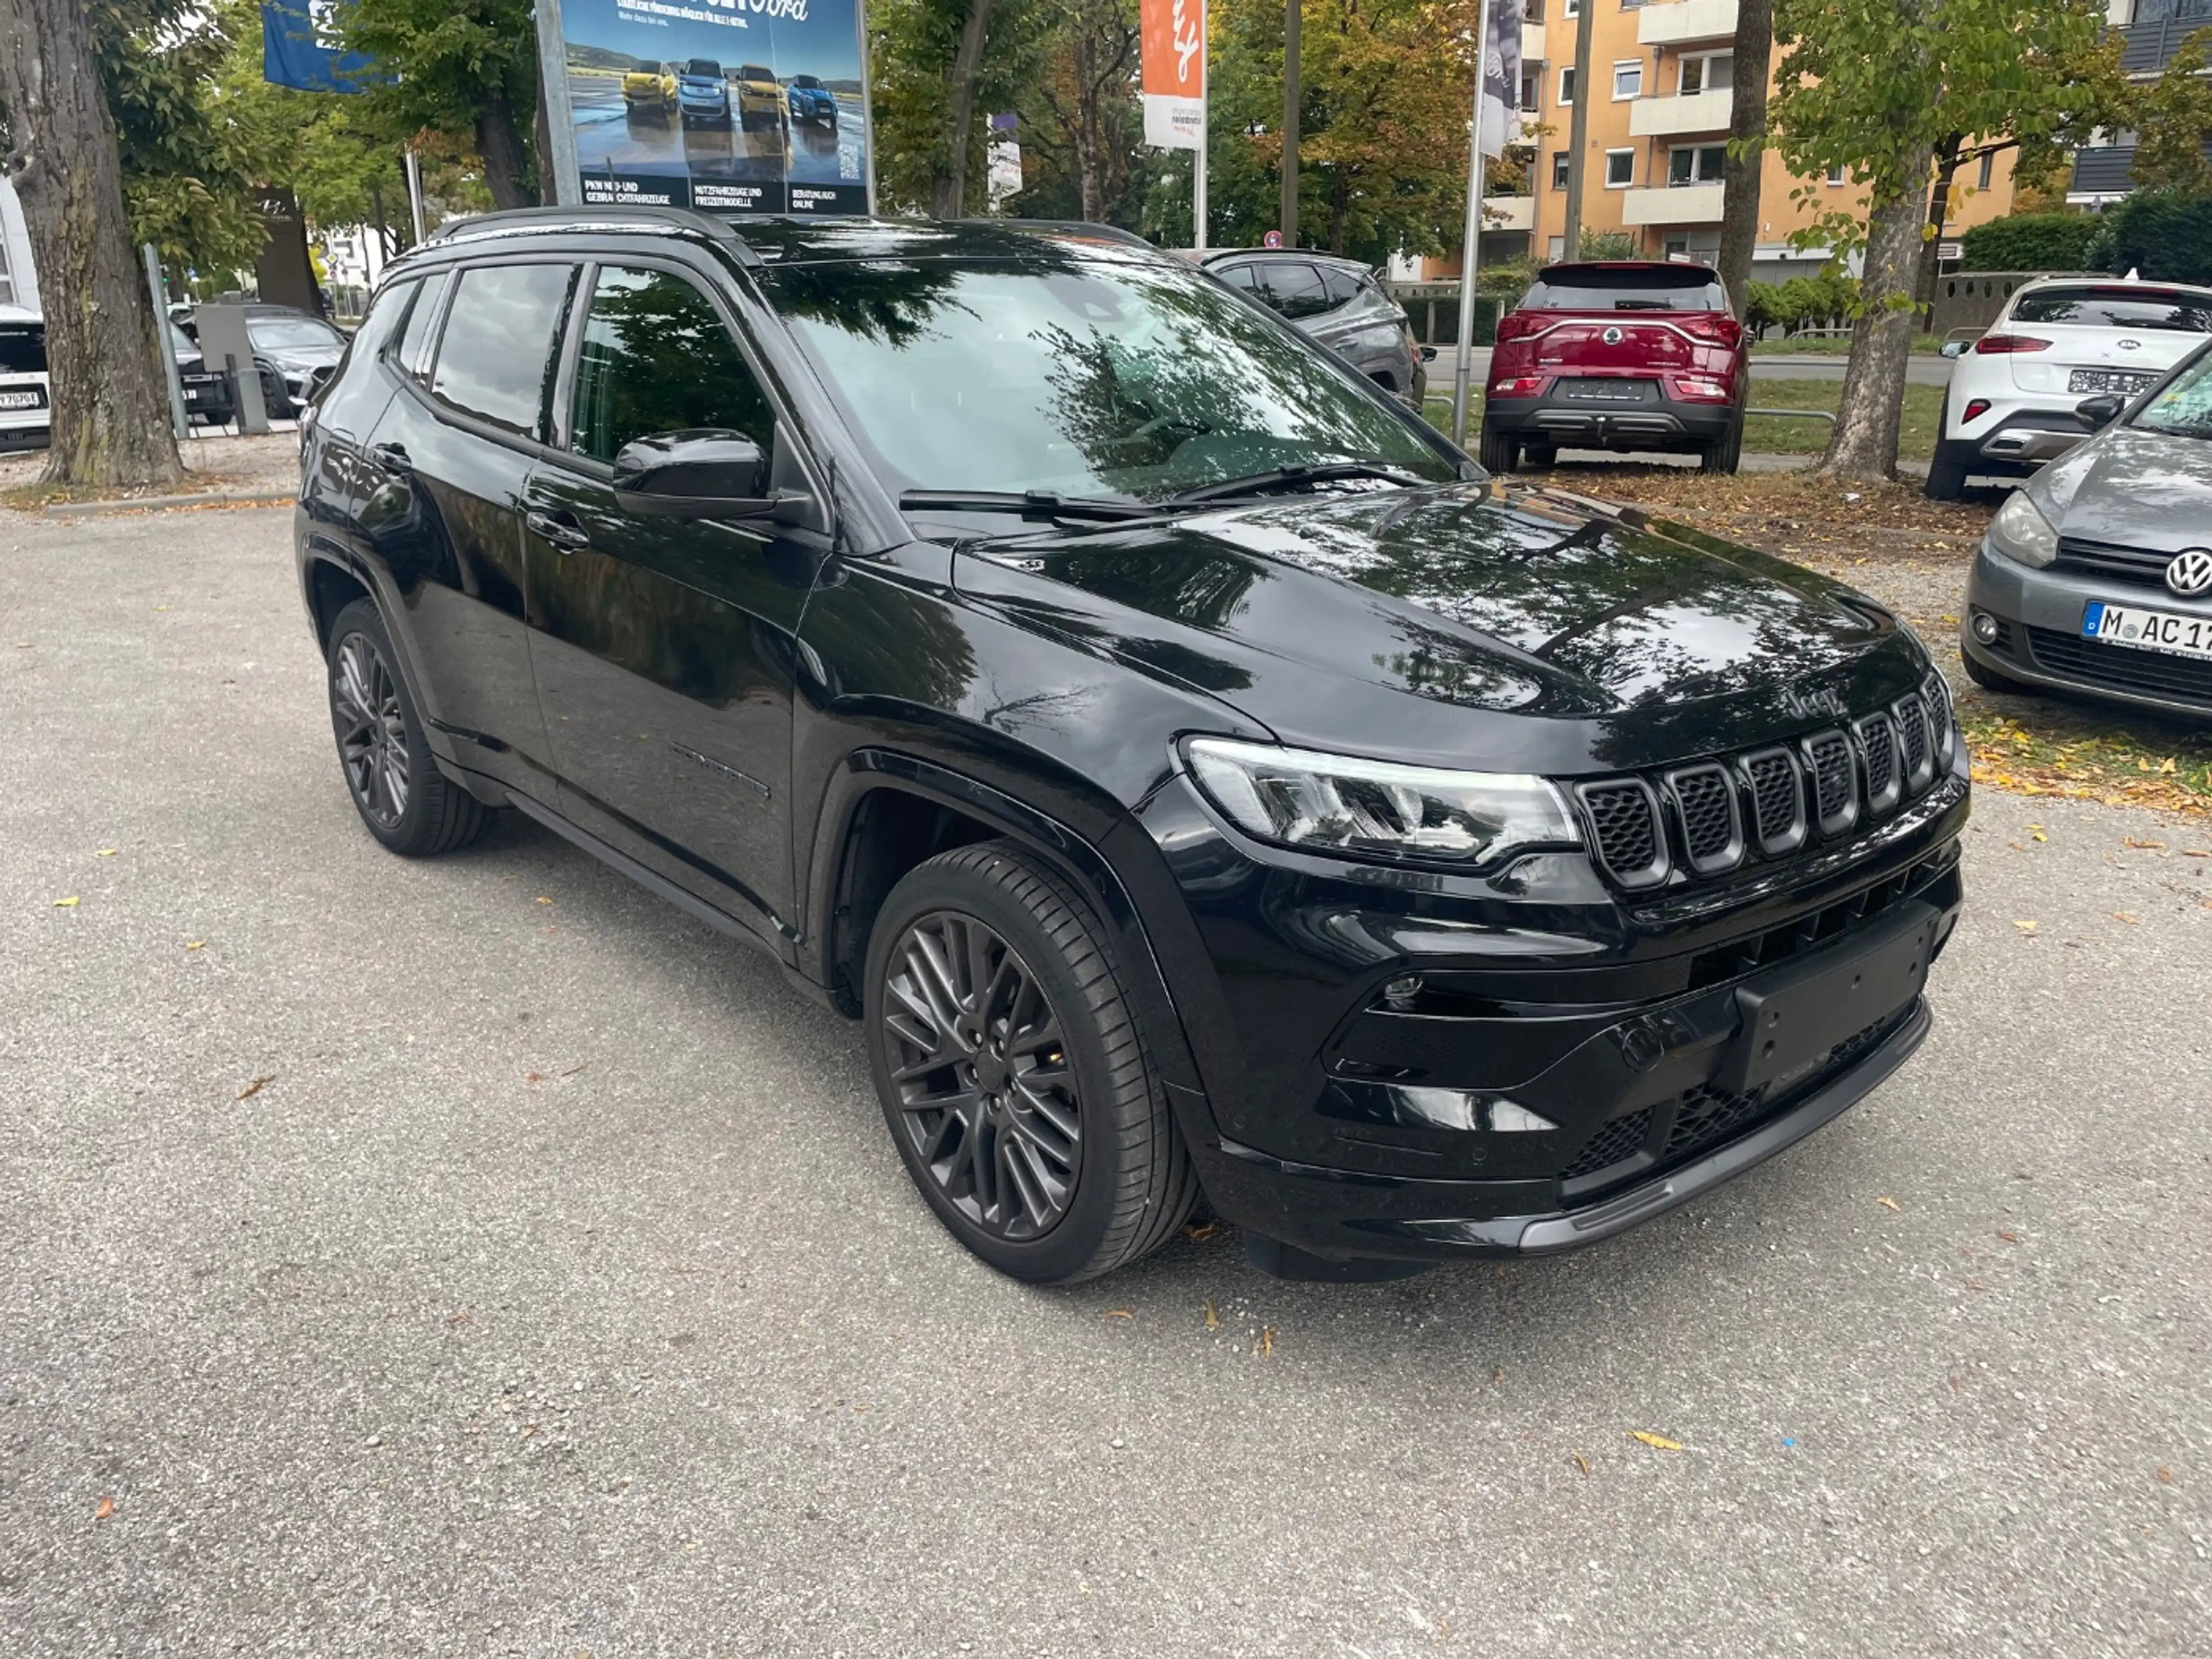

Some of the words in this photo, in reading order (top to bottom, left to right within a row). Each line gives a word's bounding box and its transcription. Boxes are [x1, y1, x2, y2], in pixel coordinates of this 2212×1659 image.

[2103, 609, 2123, 635] M
[2141, 616, 2180, 644] AC
[1788, 688, 1838, 720] Jeep
